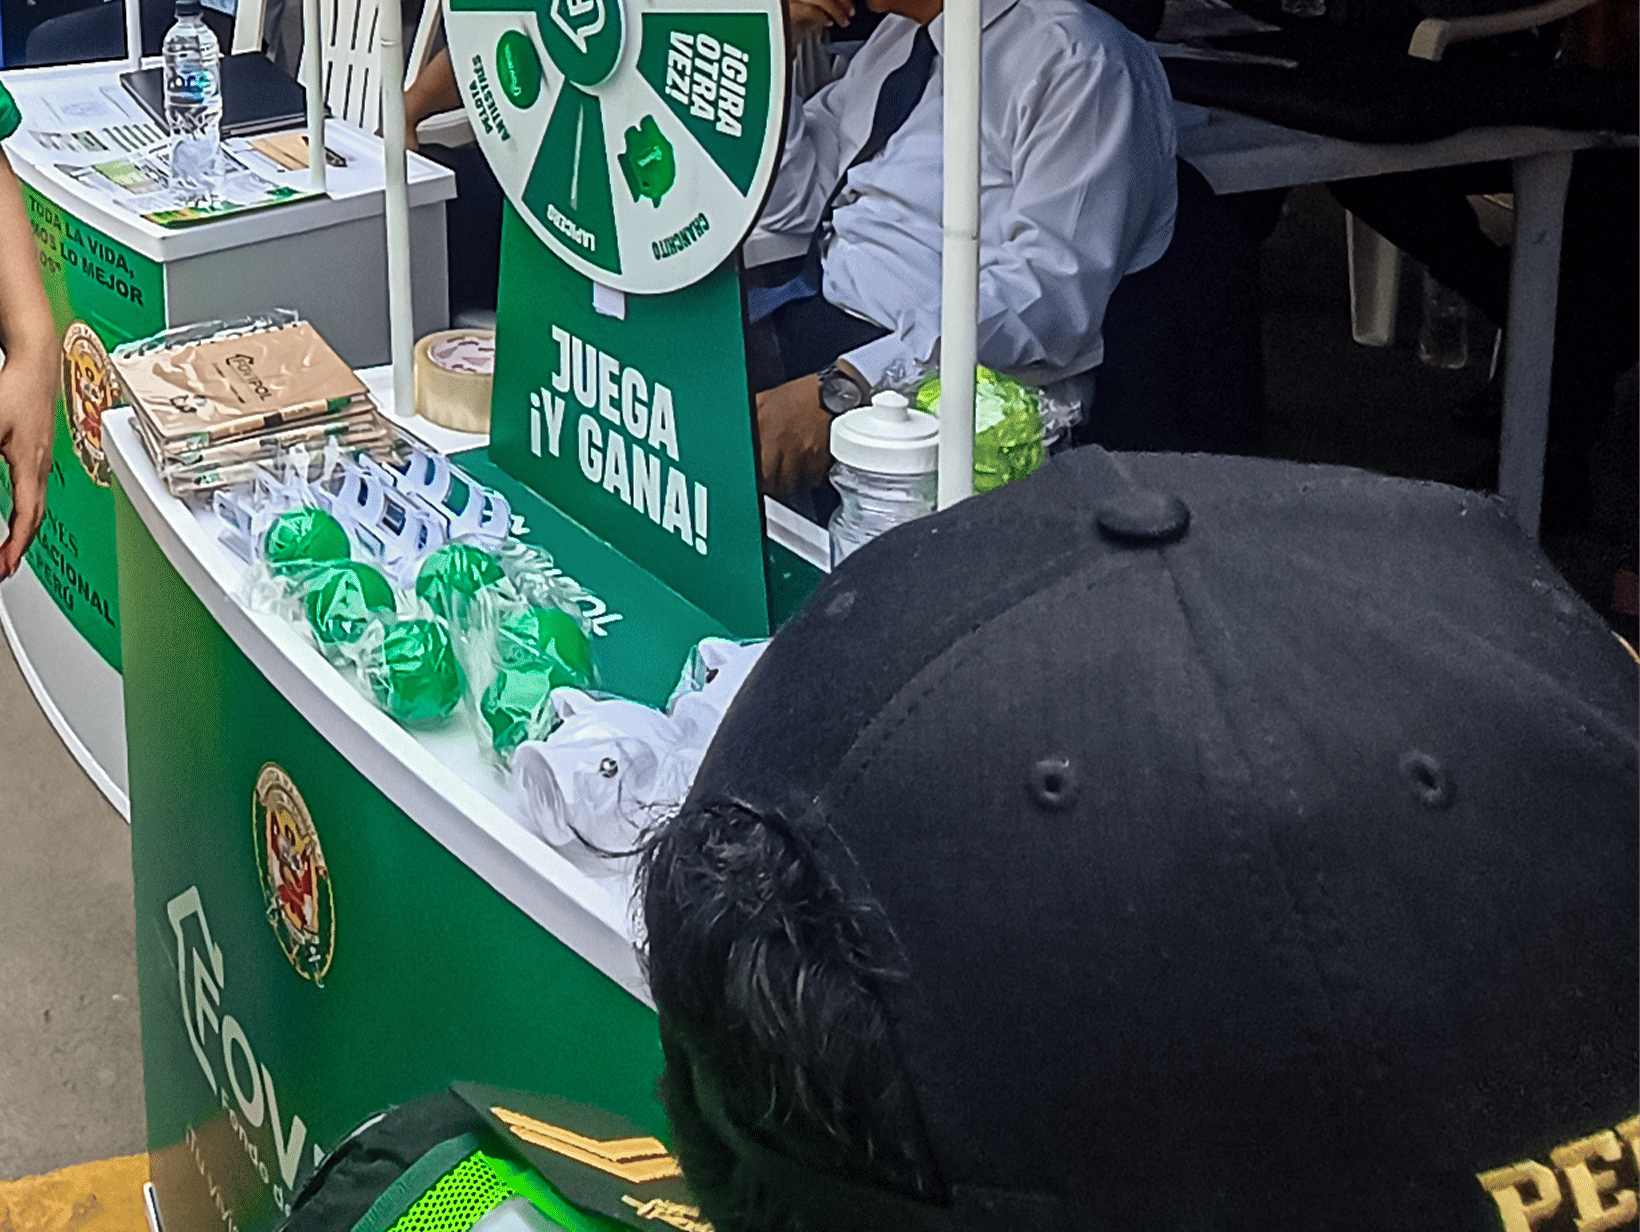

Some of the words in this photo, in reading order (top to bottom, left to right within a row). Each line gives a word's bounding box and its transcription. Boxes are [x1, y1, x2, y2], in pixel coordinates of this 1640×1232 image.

[664, 31, 695, 106] VEZ!
[689, 33, 721, 121] OTRA
[60, 242, 78, 267] LO
[81, 257, 144, 308] MEJOR
[65, 221, 85, 248] LA
[87, 235, 135, 280] VIDA,
[651, 212, 710, 261] CHANCHITO
[551, 324, 680, 462] JUEGA
[530, 386, 566, 458] ¡Y
[577, 414, 708, 556] GANA!
[190, 933, 323, 1191] FOV
[1475, 1113, 1640, 1232] PE
